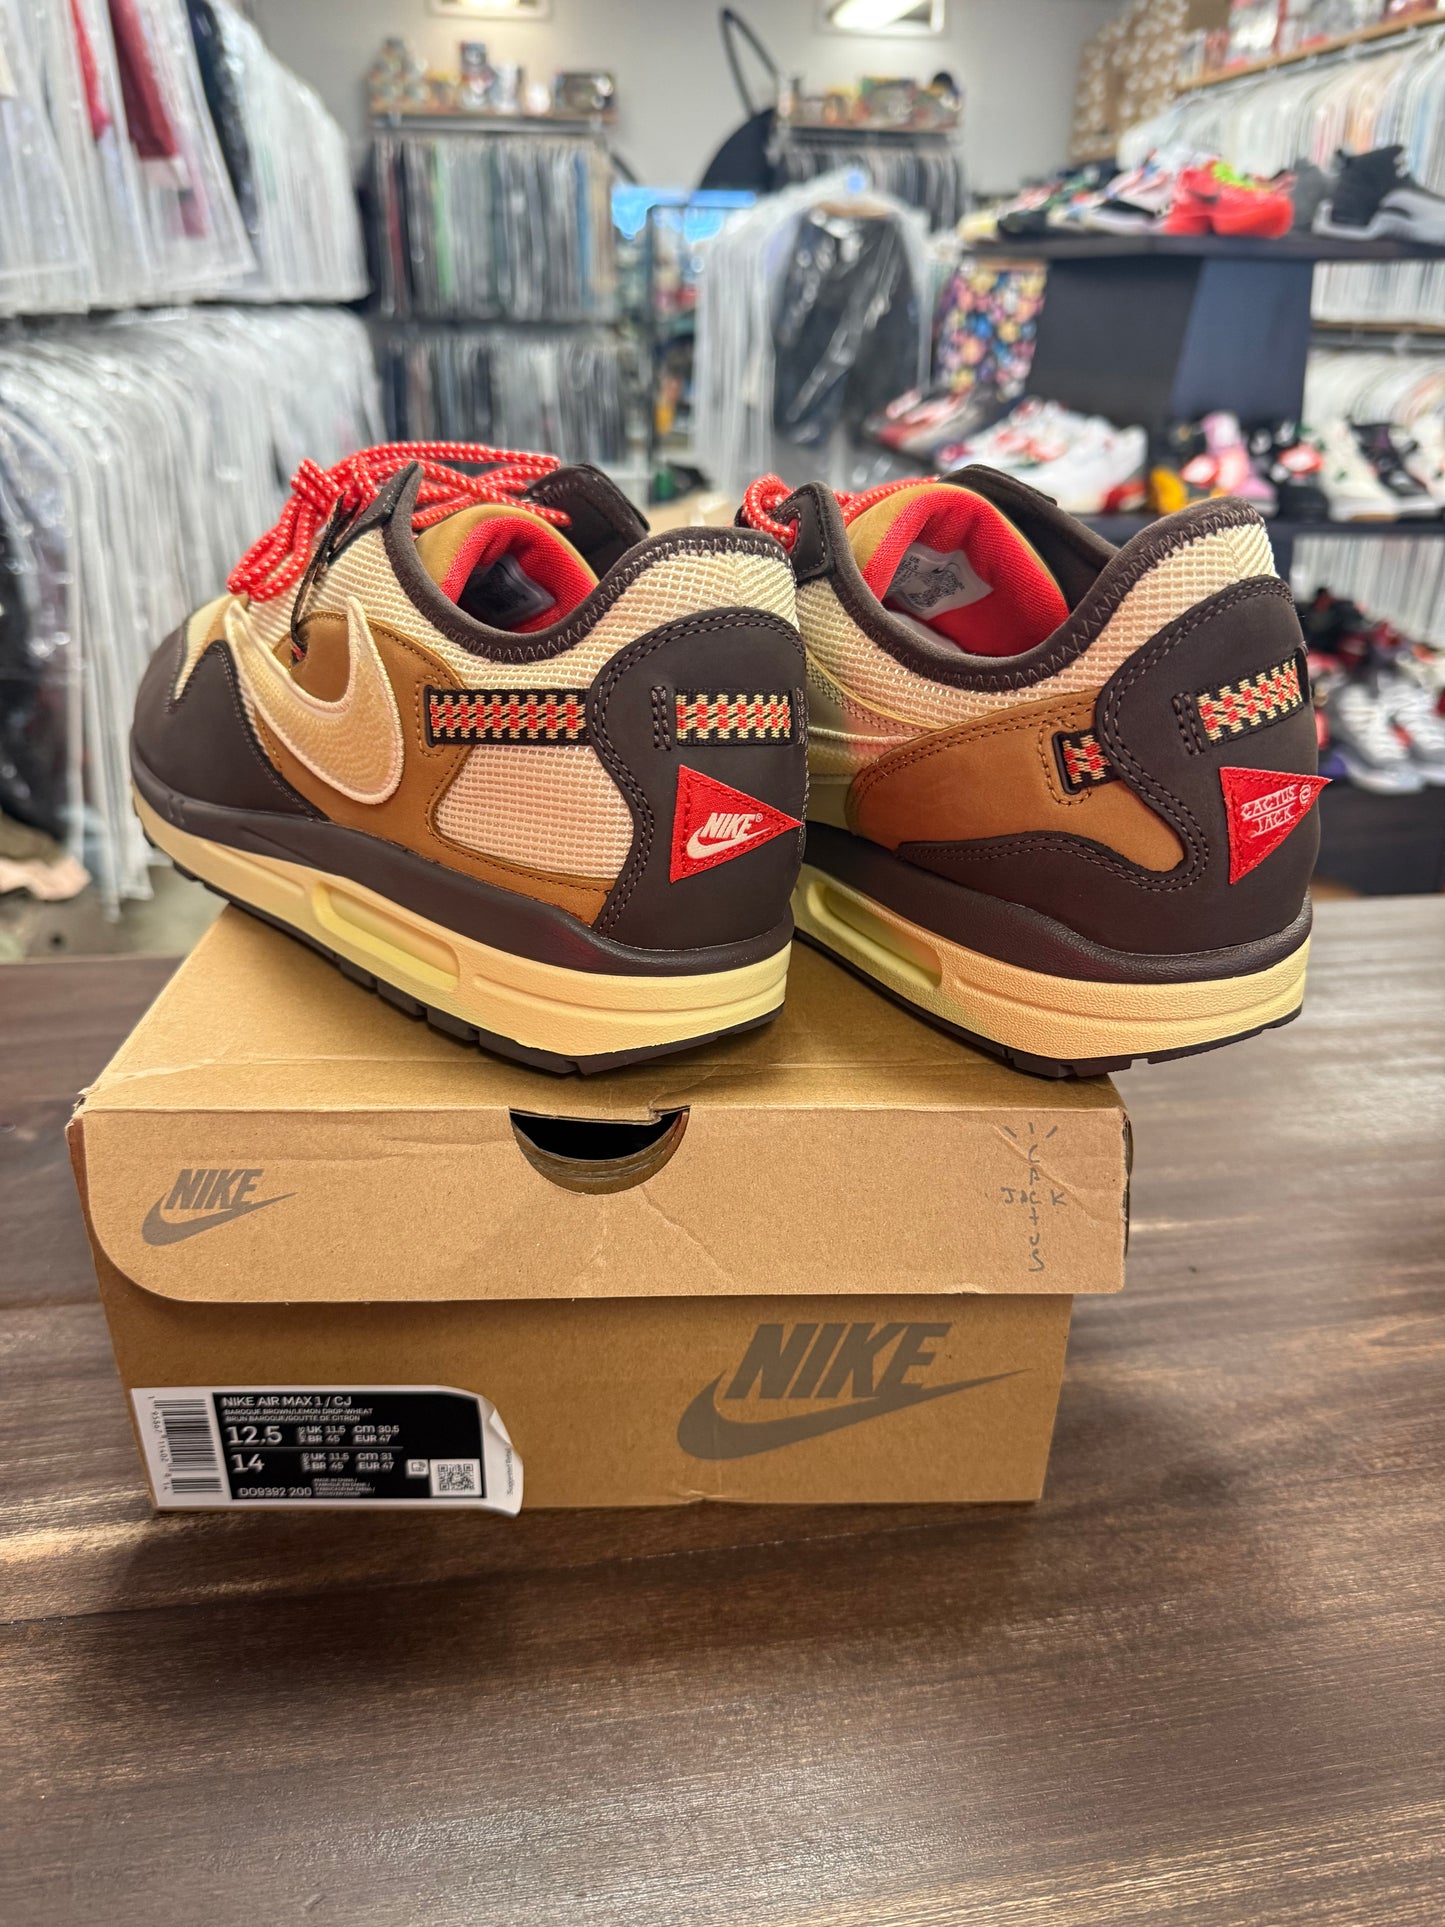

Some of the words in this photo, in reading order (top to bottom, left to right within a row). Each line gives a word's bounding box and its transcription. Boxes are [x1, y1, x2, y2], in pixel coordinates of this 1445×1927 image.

[1240, 784, 1298, 821] CACTUS
[700, 812, 756, 839] NIKE
[1250, 801, 1296, 839] JACK
[164, 1168, 264, 1210] NIKE
[724, 1322, 952, 1400] NIKE
[222, 1397, 254, 1406] NIKE
[257, 1397, 280, 1406] AIR
[283, 1397, 313, 1406] MAX
[315, 1397, 323, 1406] 1
[334, 1396, 352, 1406] CJ
[227, 1426, 283, 1444] 12.5
[306, 1425, 322, 1433] UK
[378, 1424, 400, 1433] 30.5
[355, 1434, 377, 1443] EUR
[380, 1434, 392, 1442] 47
[233, 1453, 265, 1473] 14
[310, 1452, 326, 1460] UK
[381, 1452, 394, 1460] 31
[358, 1461, 380, 1470] EUR
[382, 1461, 395, 1470] 47
[288, 1487, 312, 1497] 200
